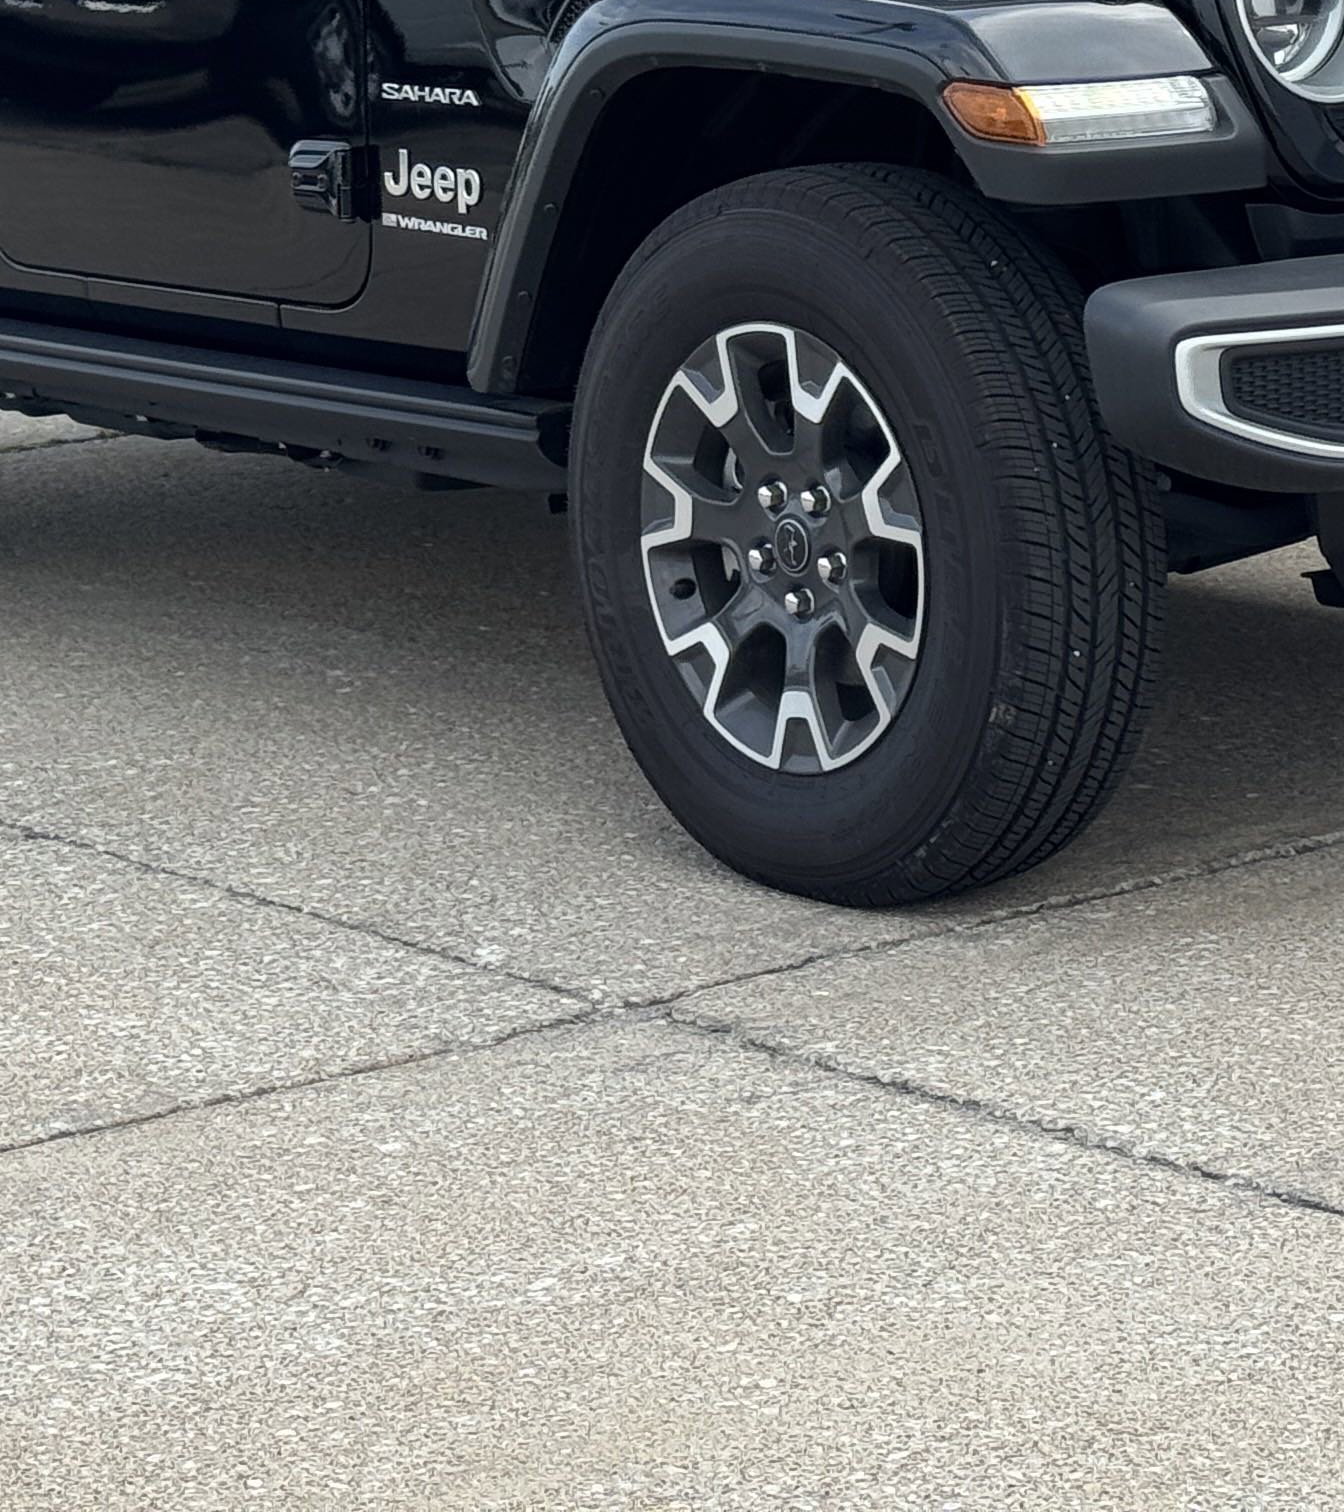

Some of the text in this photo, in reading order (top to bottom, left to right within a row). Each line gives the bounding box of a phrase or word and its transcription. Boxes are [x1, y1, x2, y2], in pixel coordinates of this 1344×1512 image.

[381, 83, 481, 106] SAHARA
[384, 148, 481, 214] Jeep
[397, 214, 489, 241] WRANGLER
